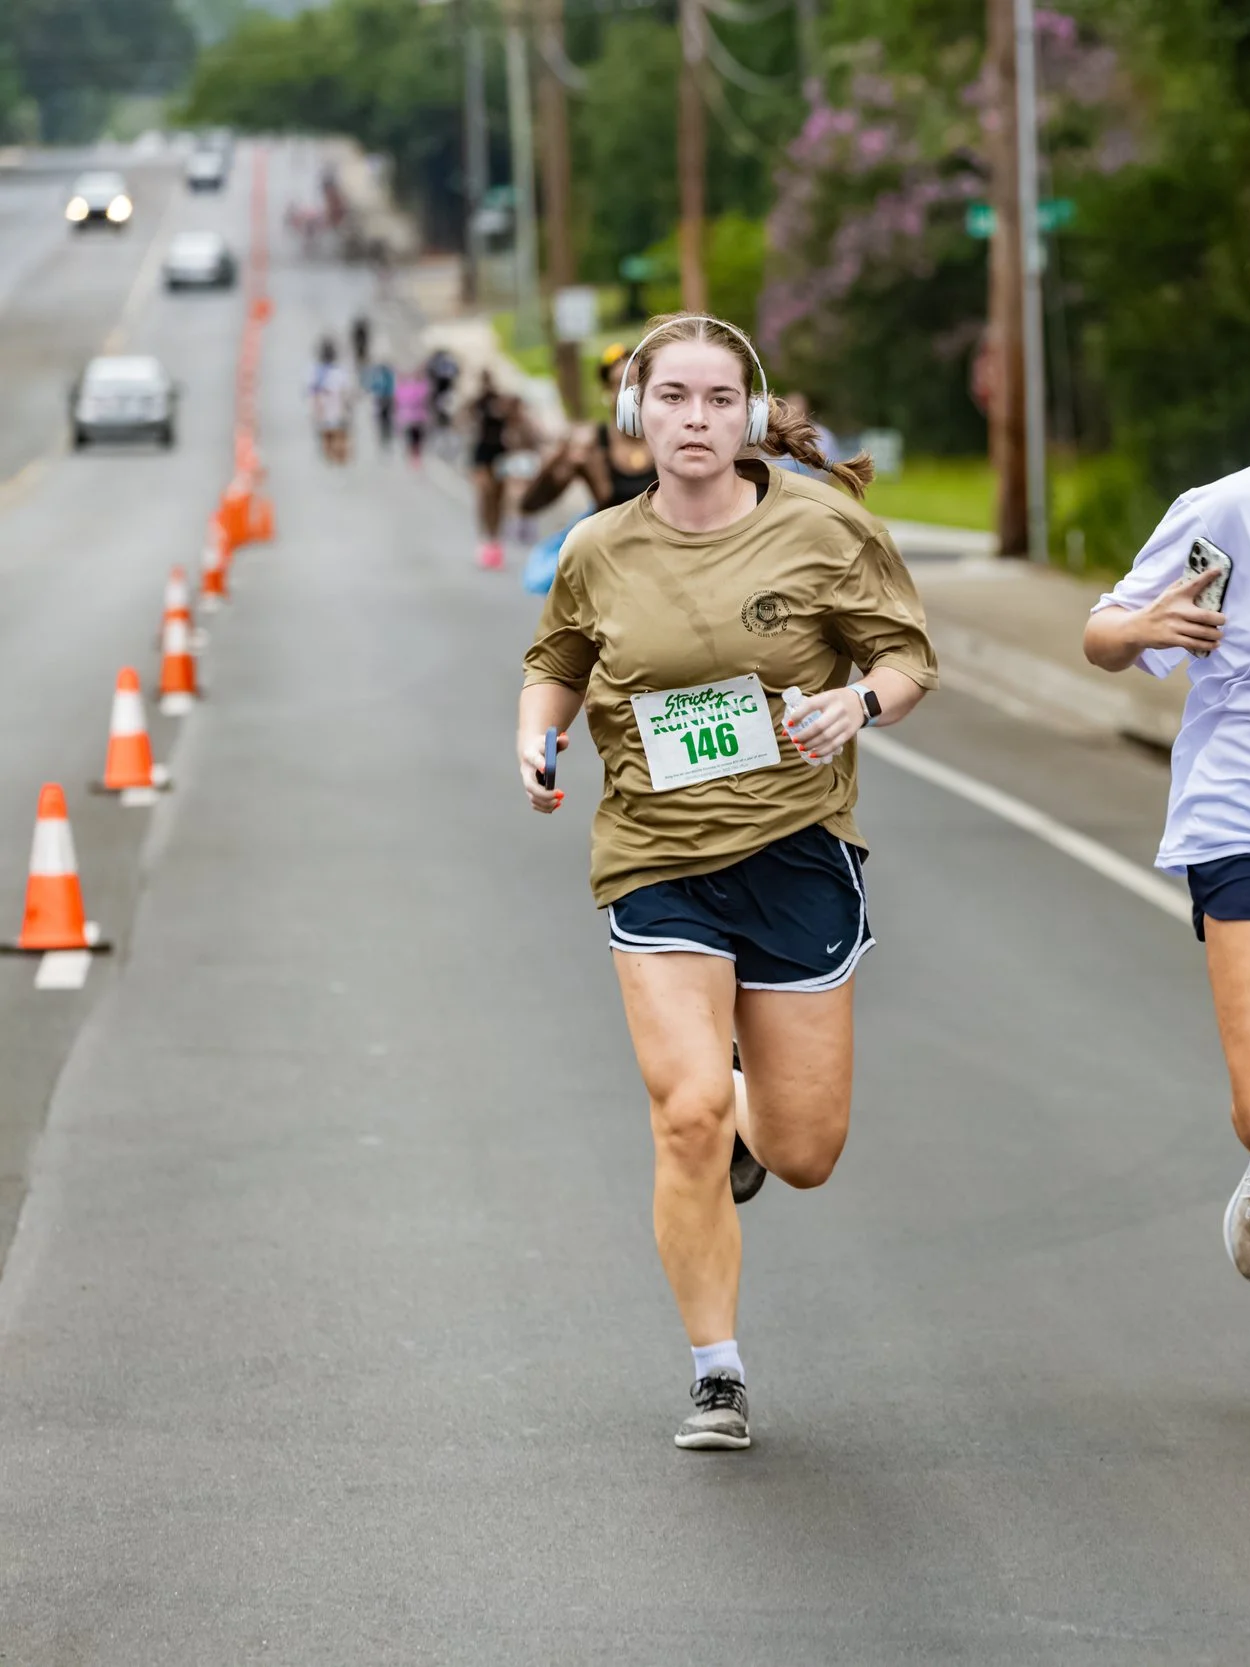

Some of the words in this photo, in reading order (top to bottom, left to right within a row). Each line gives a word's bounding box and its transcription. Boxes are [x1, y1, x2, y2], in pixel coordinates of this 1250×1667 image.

[650, 694, 758, 735] RUNNING
[664, 688, 734, 717] Strictly
[680, 722, 739, 765] 146
